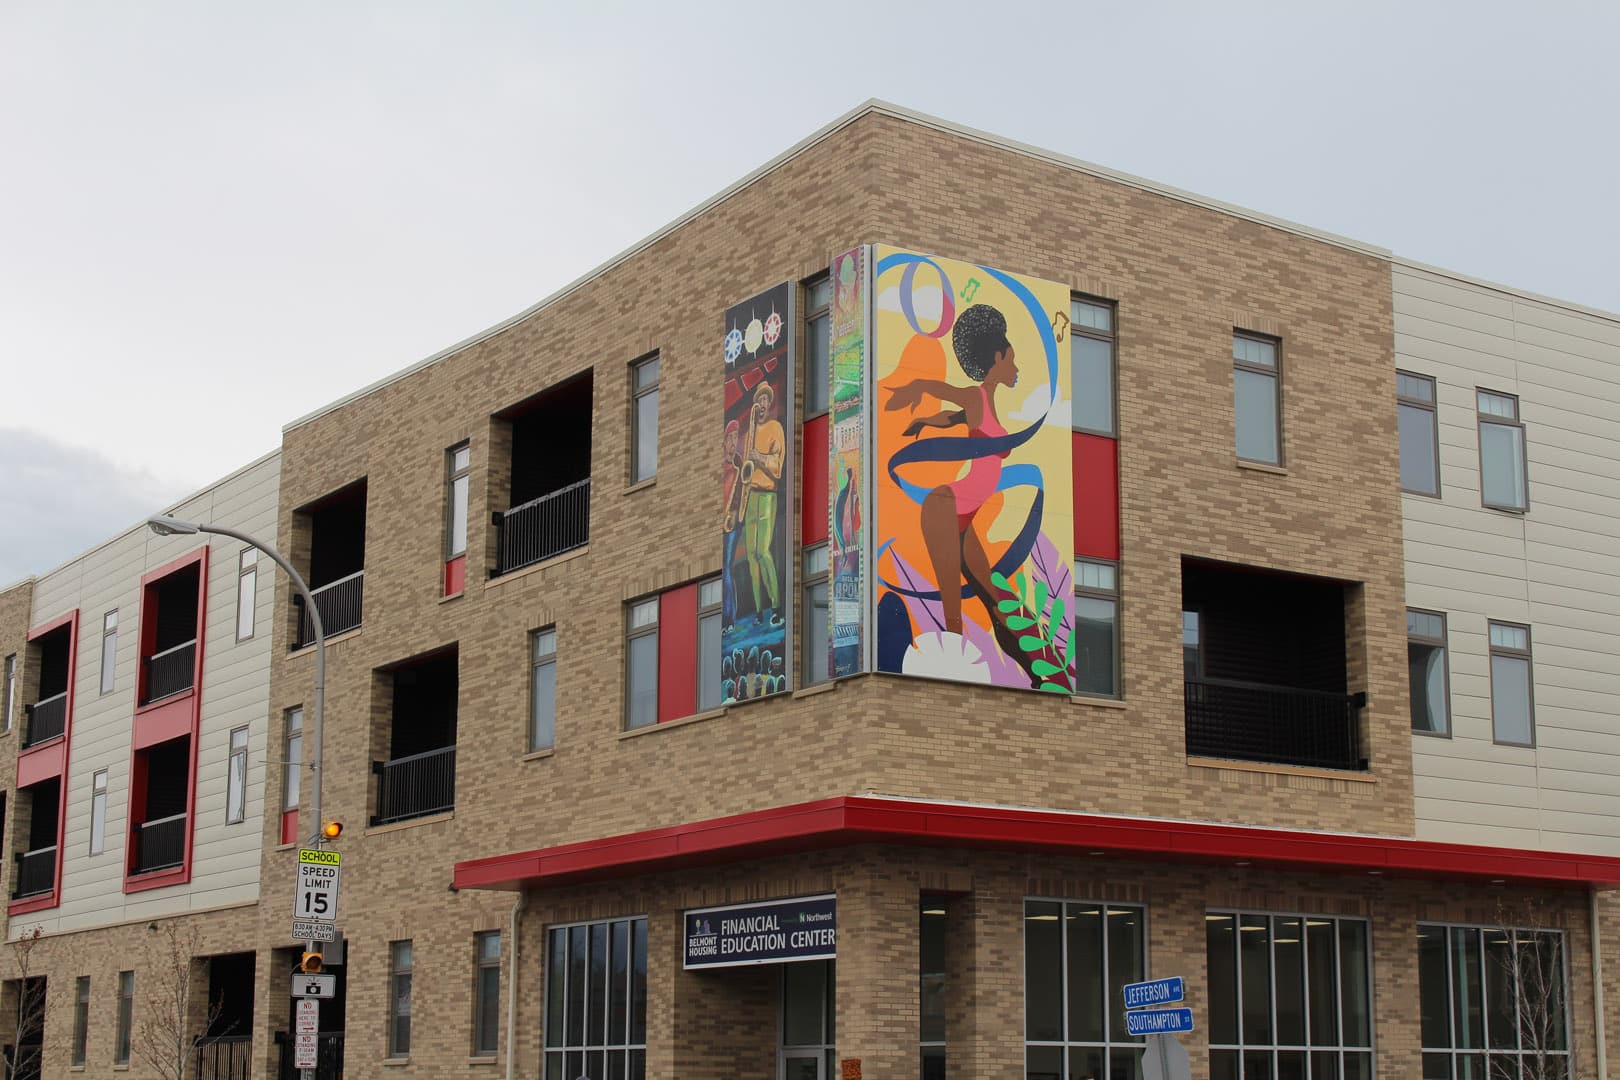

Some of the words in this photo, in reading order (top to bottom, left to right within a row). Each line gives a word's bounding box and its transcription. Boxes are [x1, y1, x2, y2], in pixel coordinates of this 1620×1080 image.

[301, 852, 338, 863] SCHOOL
[302, 866, 335, 878] SPEED
[305, 878, 332, 889] LIMIT
[305, 891, 328, 914] 15
[806, 912, 832, 922] Northwest
[721, 914, 780, 935] FINANCIAL
[294, 930, 315, 938] SCHOOL
[689, 936, 717, 947] BELMONT
[721, 933, 786, 954] EDUCATION
[790, 928, 835, 948] CENTER
[688, 945, 717, 957] HOUSING
[1127, 982, 1170, 1005] JEFFERSON
[1129, 1012, 1181, 1031] SOUTHAMPTON
